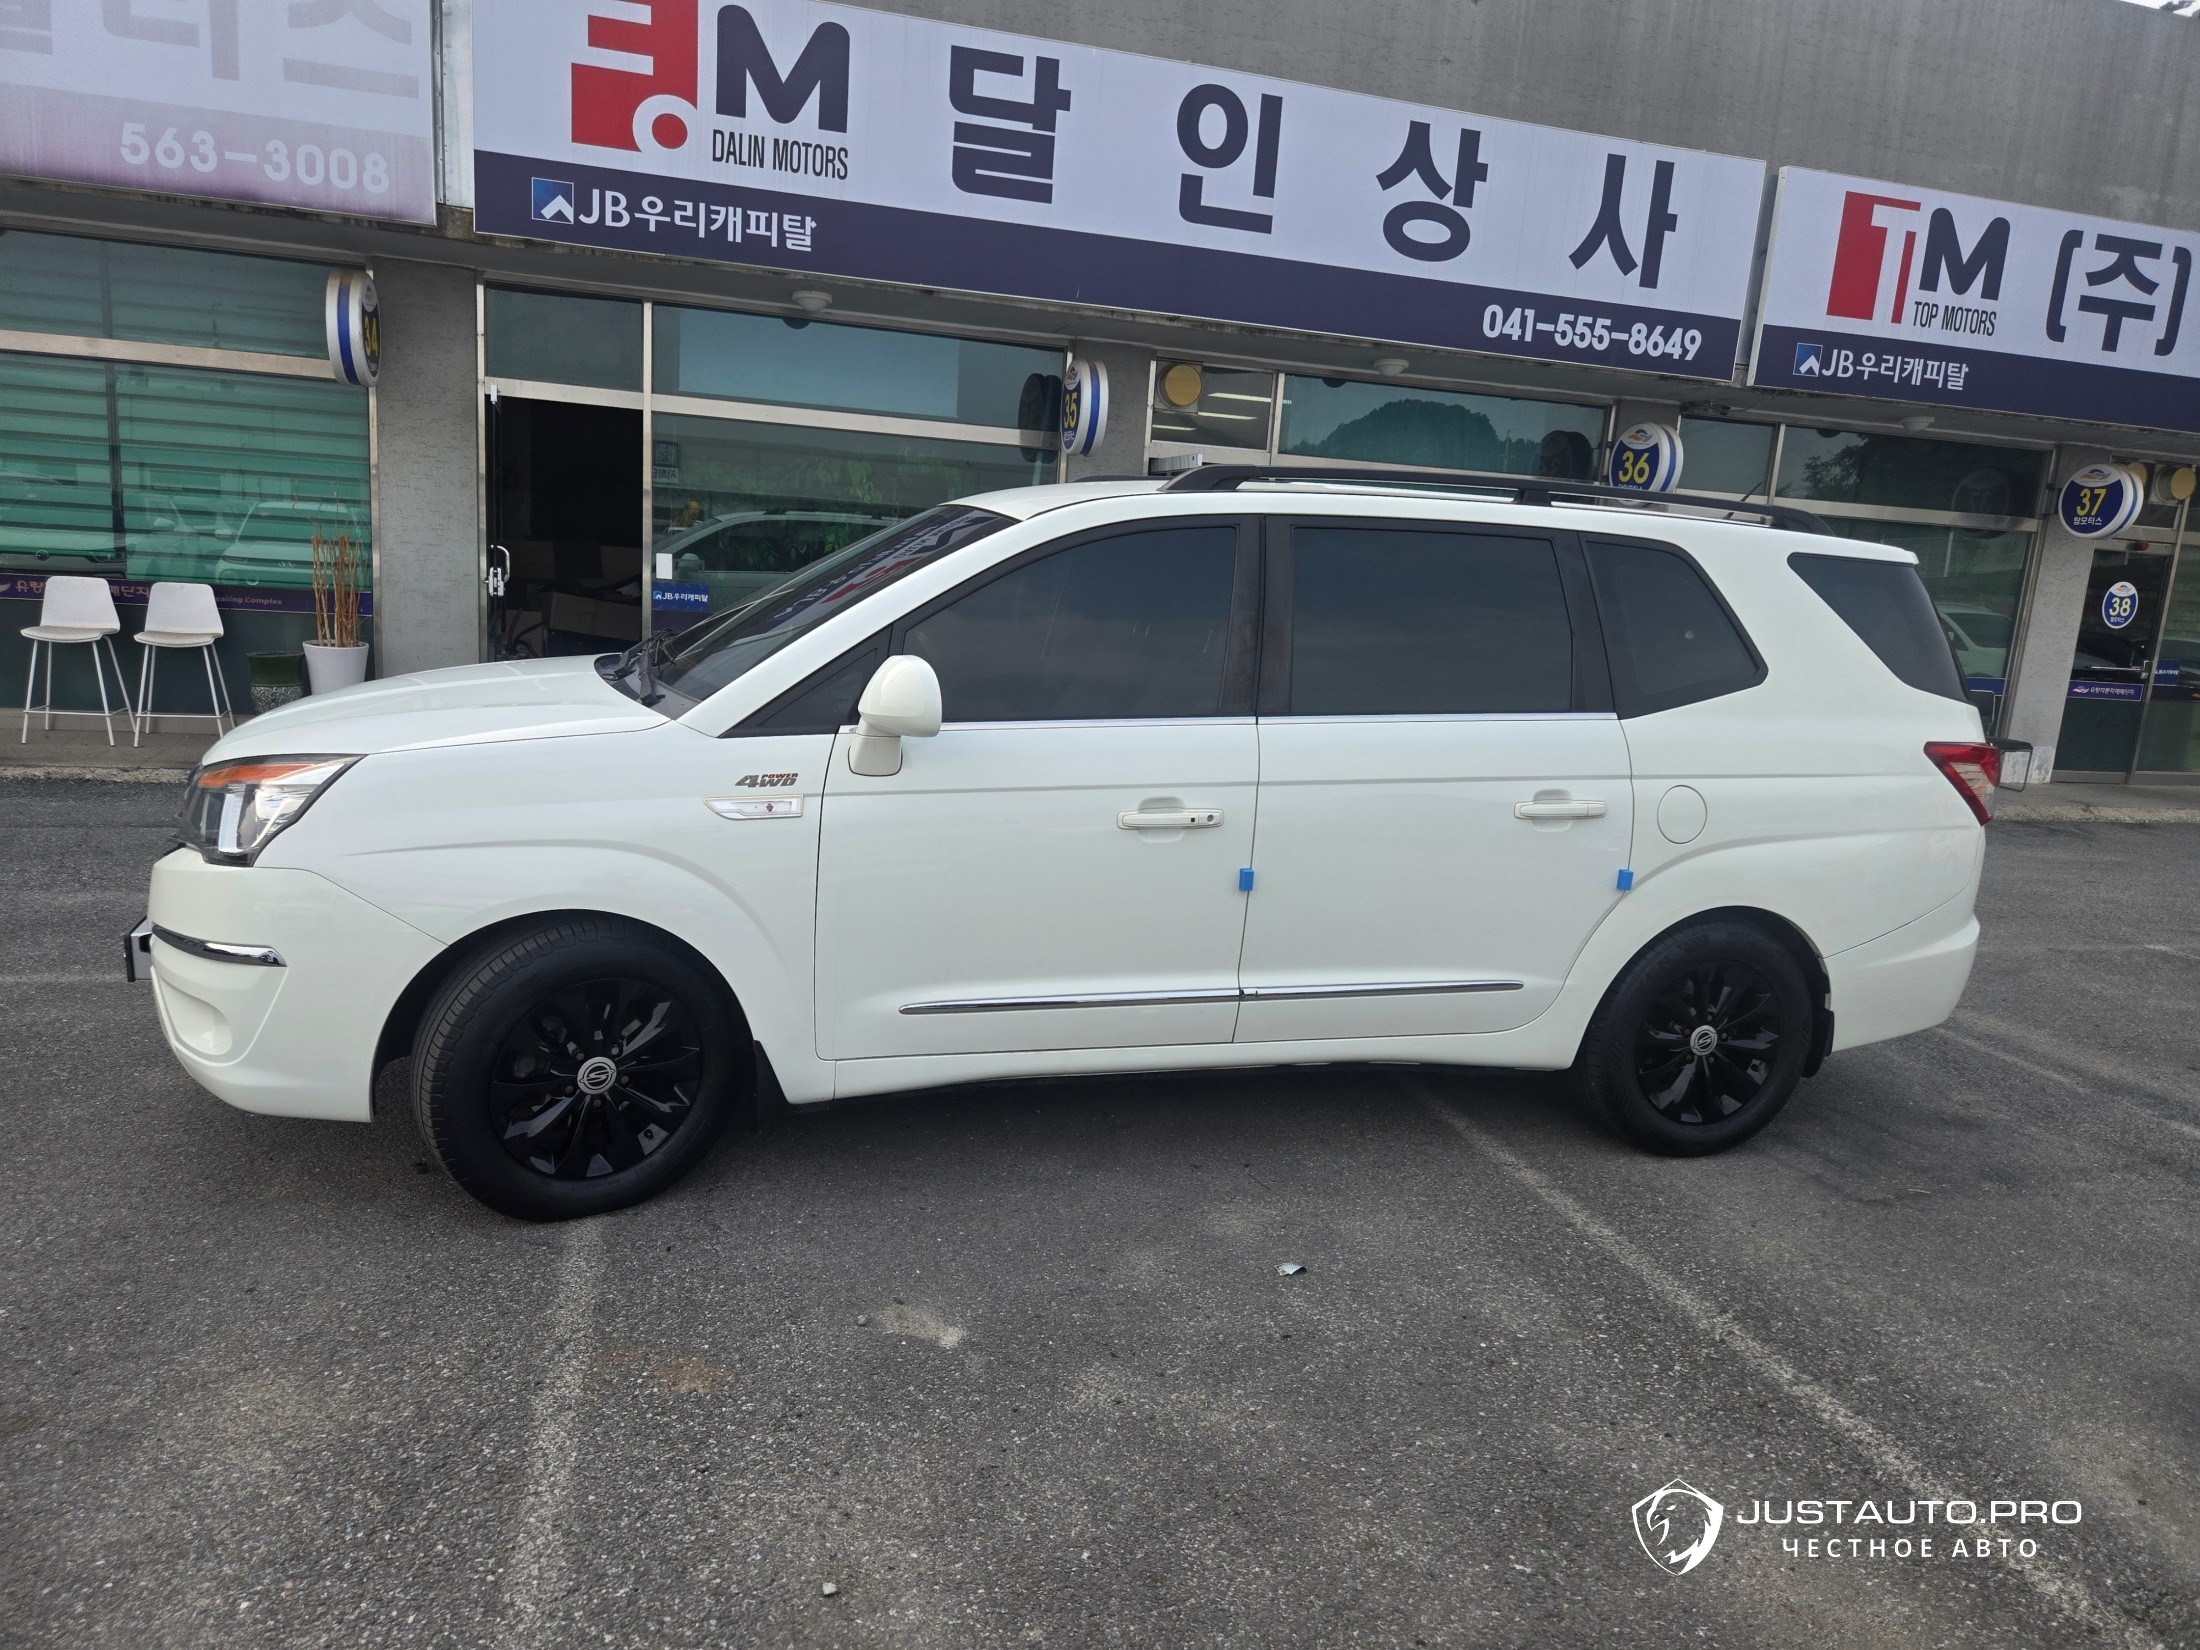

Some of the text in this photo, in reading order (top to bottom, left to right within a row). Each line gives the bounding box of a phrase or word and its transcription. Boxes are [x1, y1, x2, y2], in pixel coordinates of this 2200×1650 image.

[120, 122, 390, 194] 563-3008
[712, 129, 848, 181] DALIN MOTORS
[578, 188, 817, 252] JB우리캐피탈
[364, 315, 379, 357] 34
[1482, 304, 1702, 361] 041-555-8649
[1913, 301, 1997, 337] TOP MOTORS
[1821, 349, 1969, 391] JB우리캐피탈
[1063, 392, 1078, 429] 35
[1618, 450, 1650, 484] 36
[2076, 488, 2107, 516] 37
[2109, 597, 2131, 617] 38
[735, 775, 798, 788] 4WD
